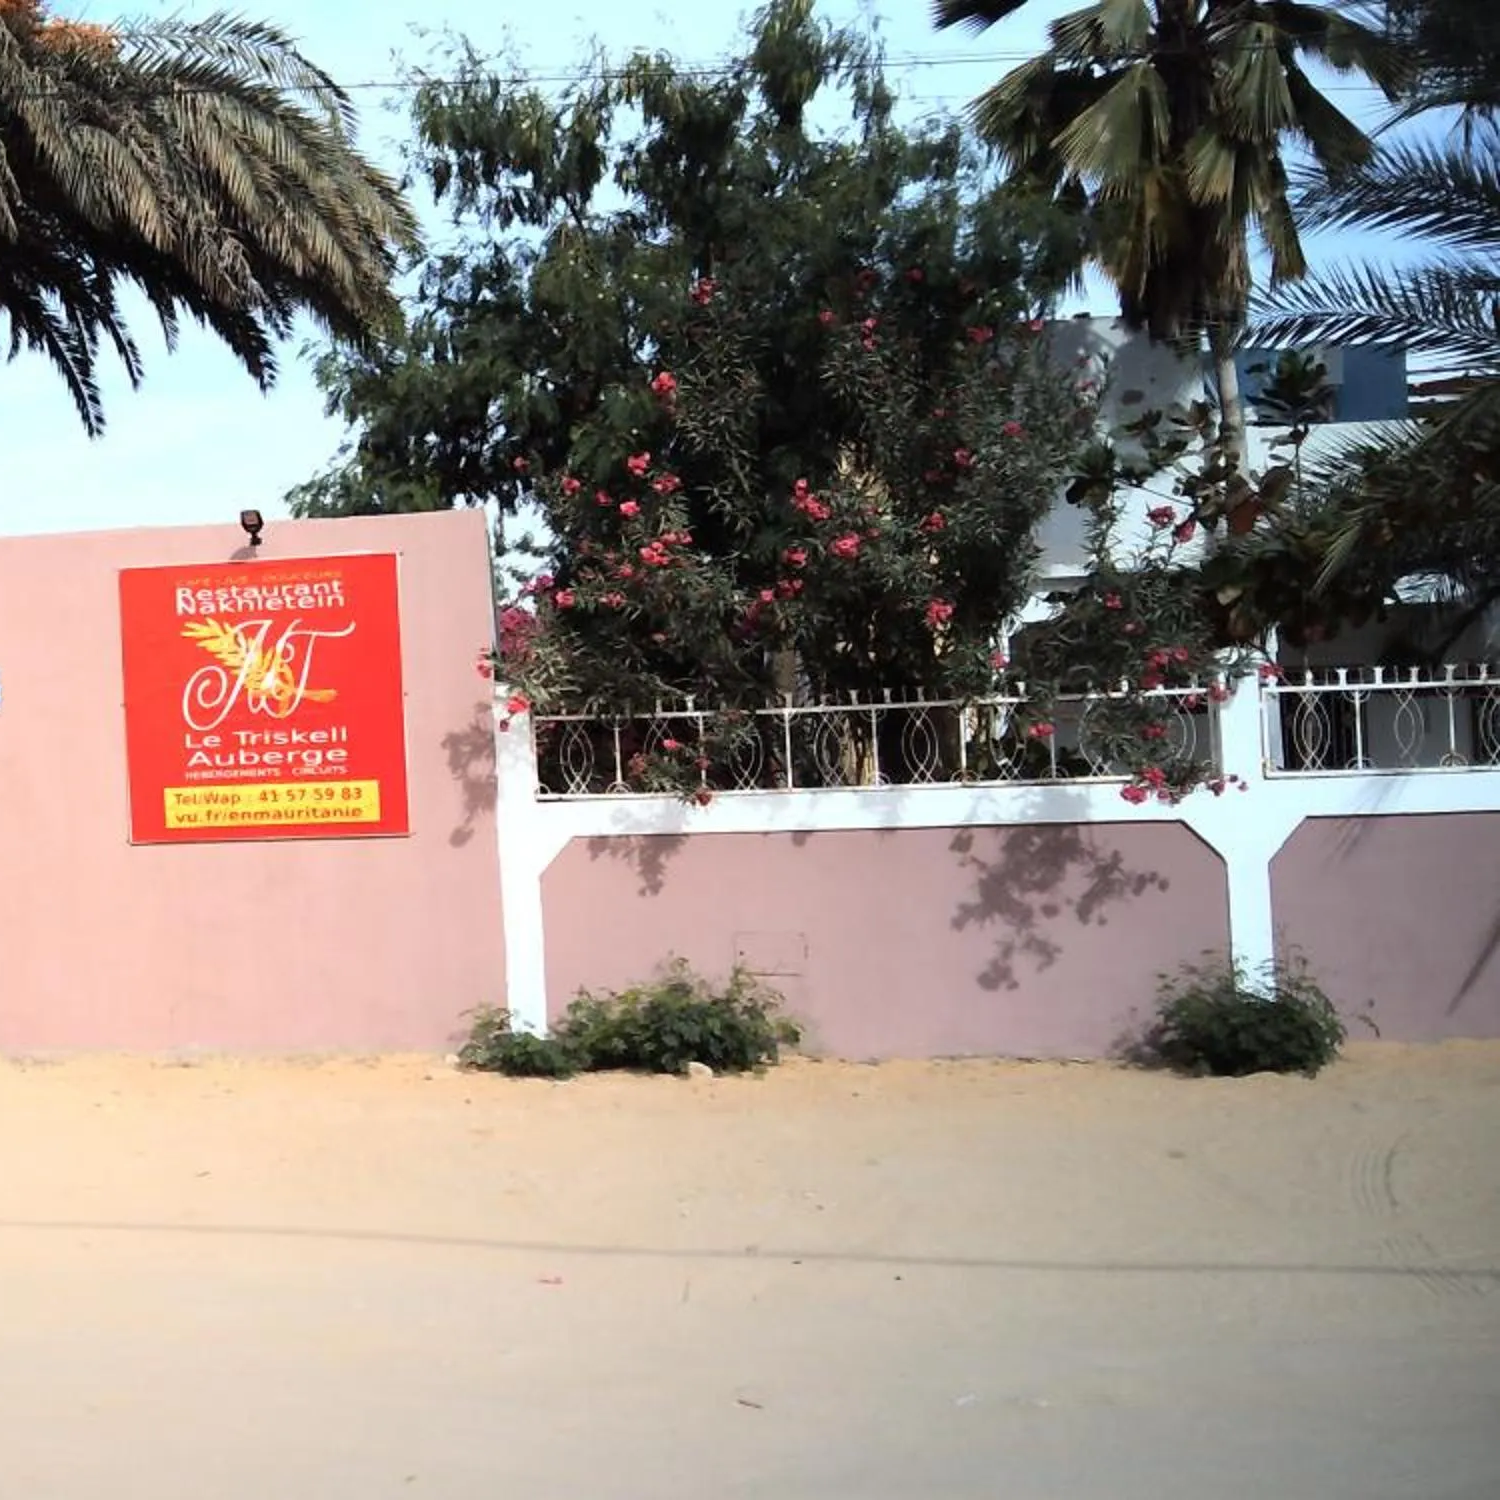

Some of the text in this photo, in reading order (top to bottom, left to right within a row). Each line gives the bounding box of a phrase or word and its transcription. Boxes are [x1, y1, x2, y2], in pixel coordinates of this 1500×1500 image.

[175, 579, 343, 601] Restaurant
[185, 726, 348, 749] Le Triskell
[187, 747, 349, 767] Auberge
[259, 789, 278, 802] 41
[286, 788, 306, 801] 57
[314, 788, 335, 801] 59
[341, 787, 362, 800] 83
